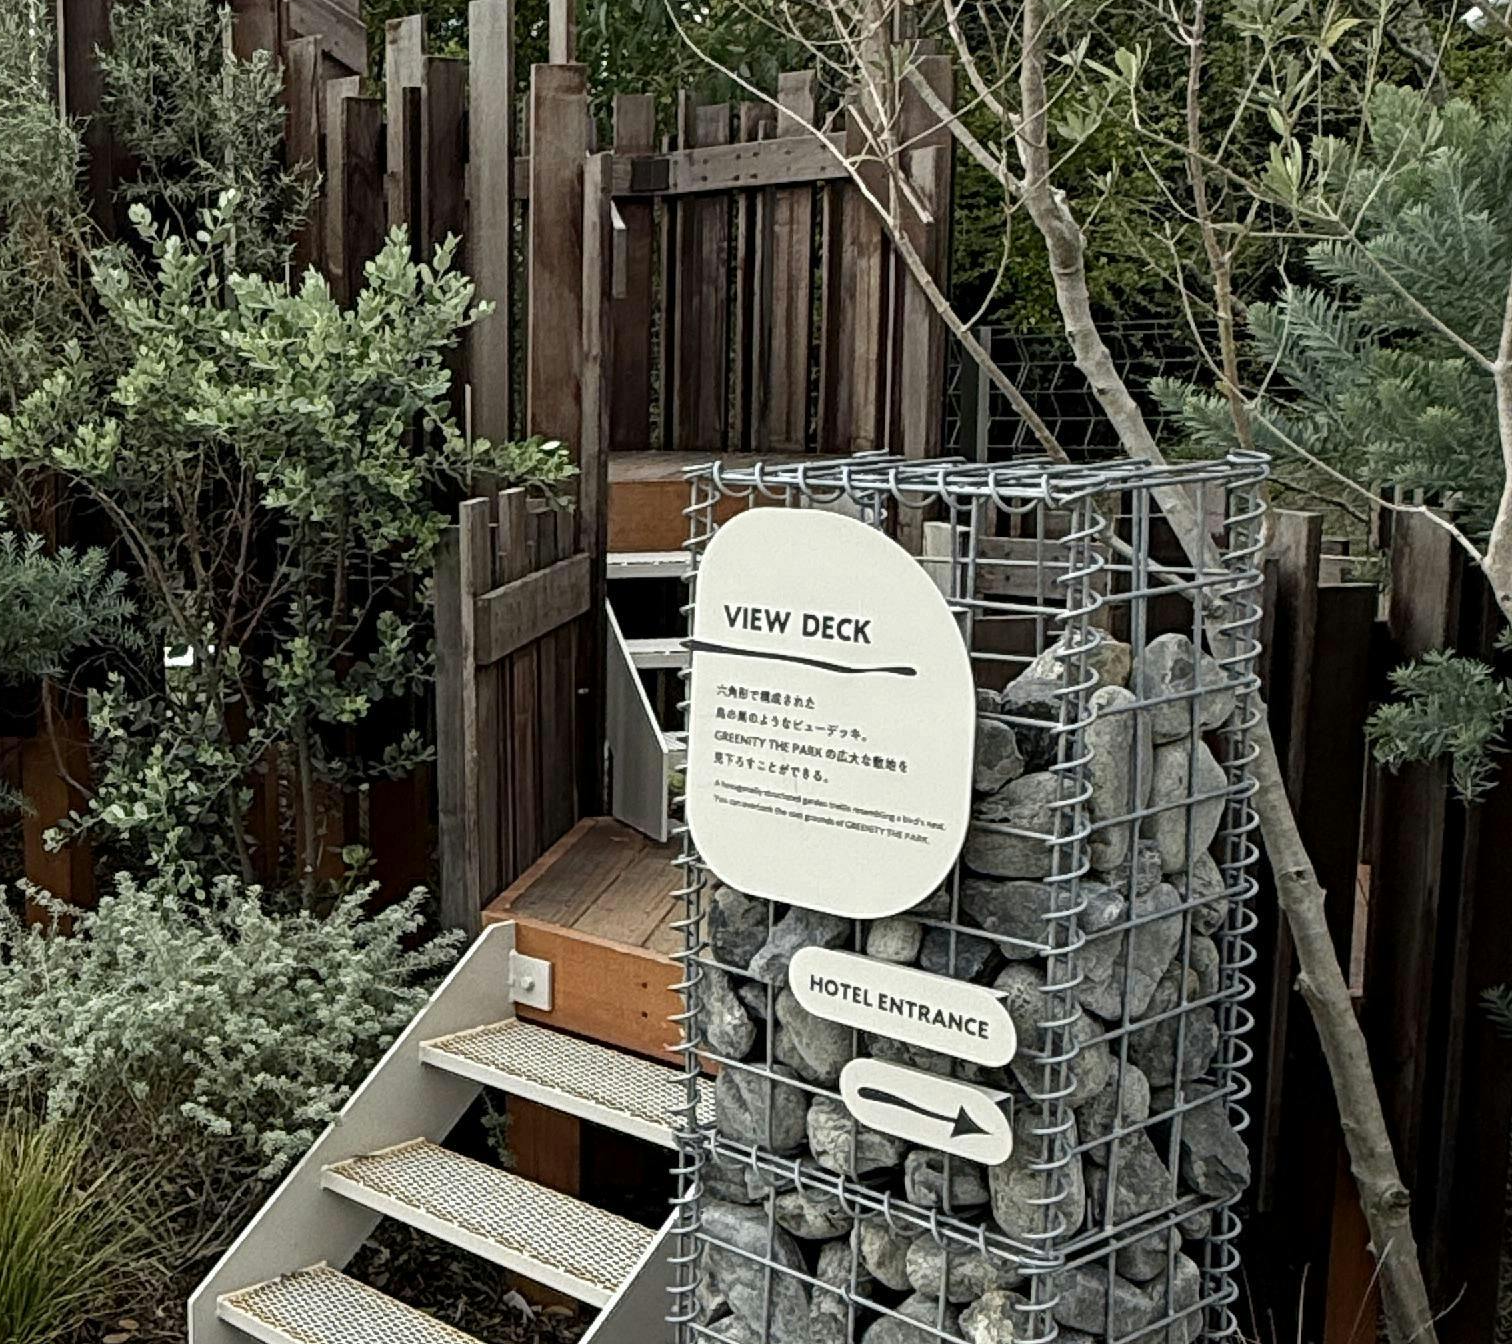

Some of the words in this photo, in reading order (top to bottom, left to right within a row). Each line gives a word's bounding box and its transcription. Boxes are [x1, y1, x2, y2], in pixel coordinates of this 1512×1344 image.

[723, 604, 791, 634] VIEW
[802, 613, 872, 644] DECK
[769, 738, 790, 753] THE
[792, 742, 823, 758] PARK
[809, 974, 874, 1008] HOTEL
[878, 992, 990, 1040] ENTRANCE
